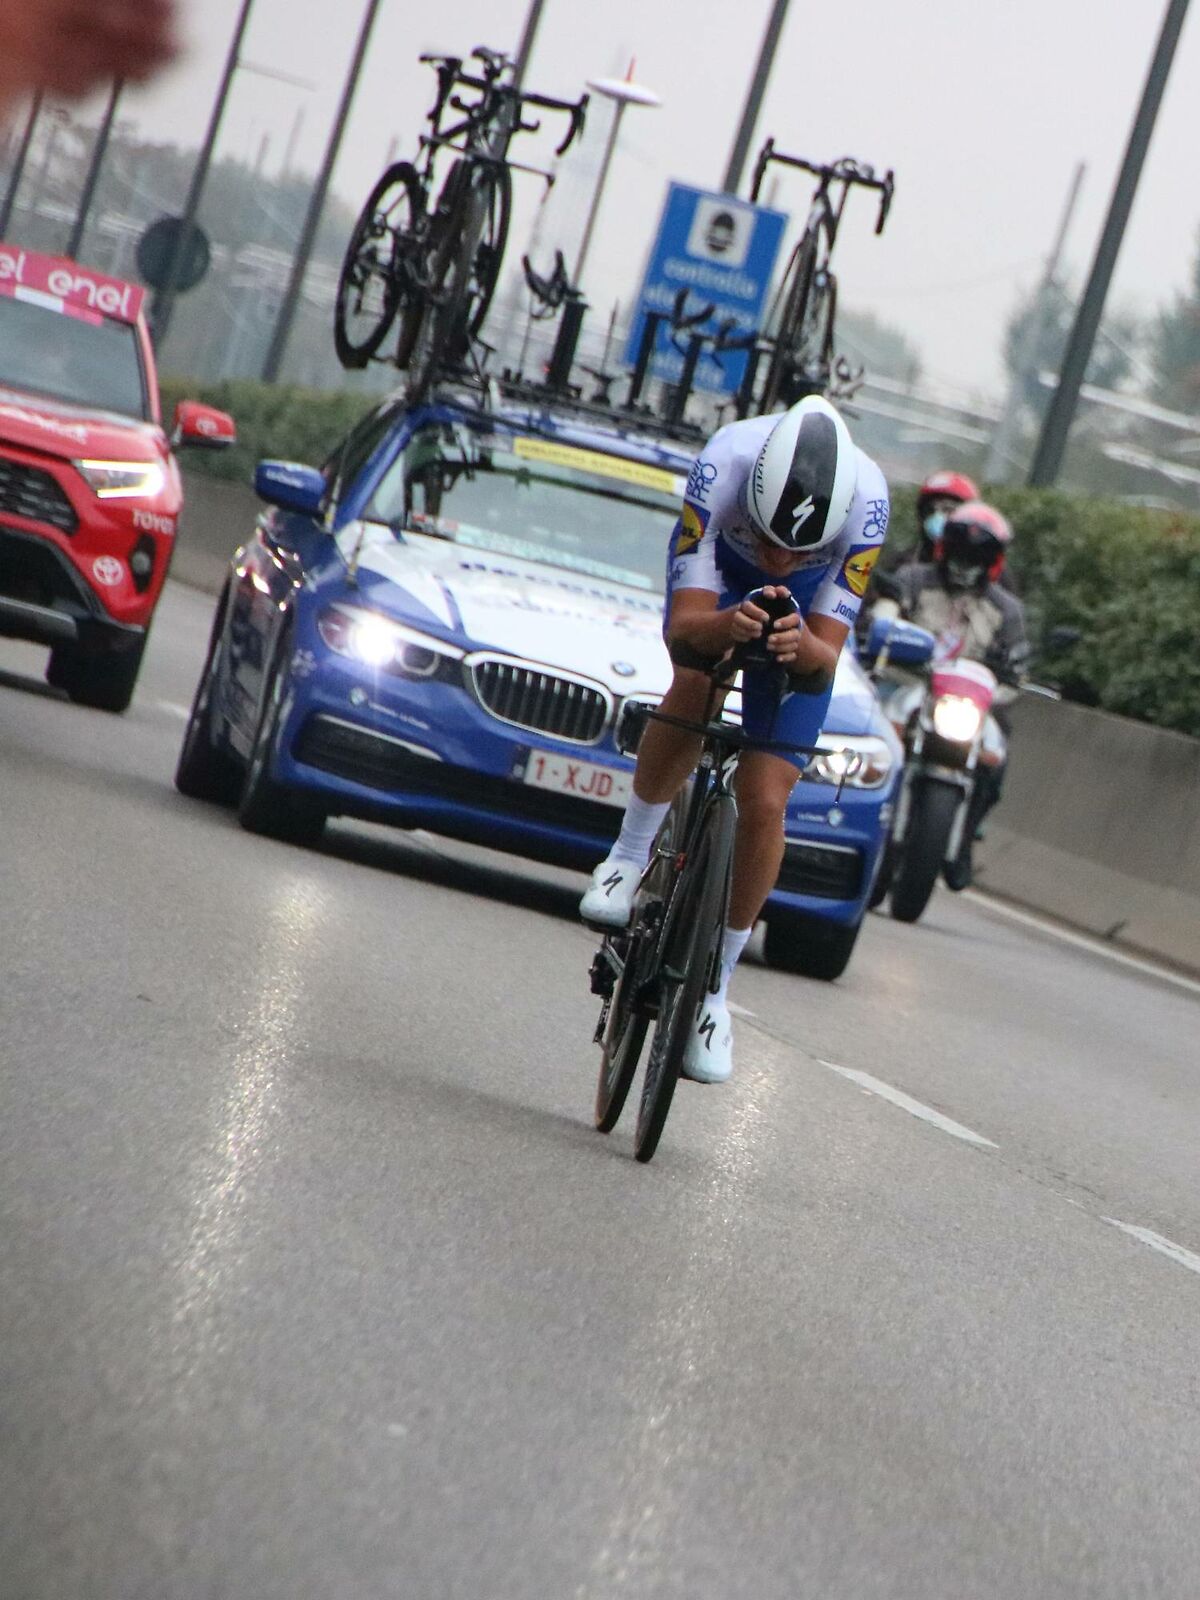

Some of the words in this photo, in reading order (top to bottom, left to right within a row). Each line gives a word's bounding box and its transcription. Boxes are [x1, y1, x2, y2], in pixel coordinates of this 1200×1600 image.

[0, 249, 26, 284] el
[47, 269, 131, 318] enel
[690, 462, 717, 503] PRO
[132, 508, 175, 536] TOYO
[862, 499, 884, 538] PRO
[831, 600, 858, 622] jano
